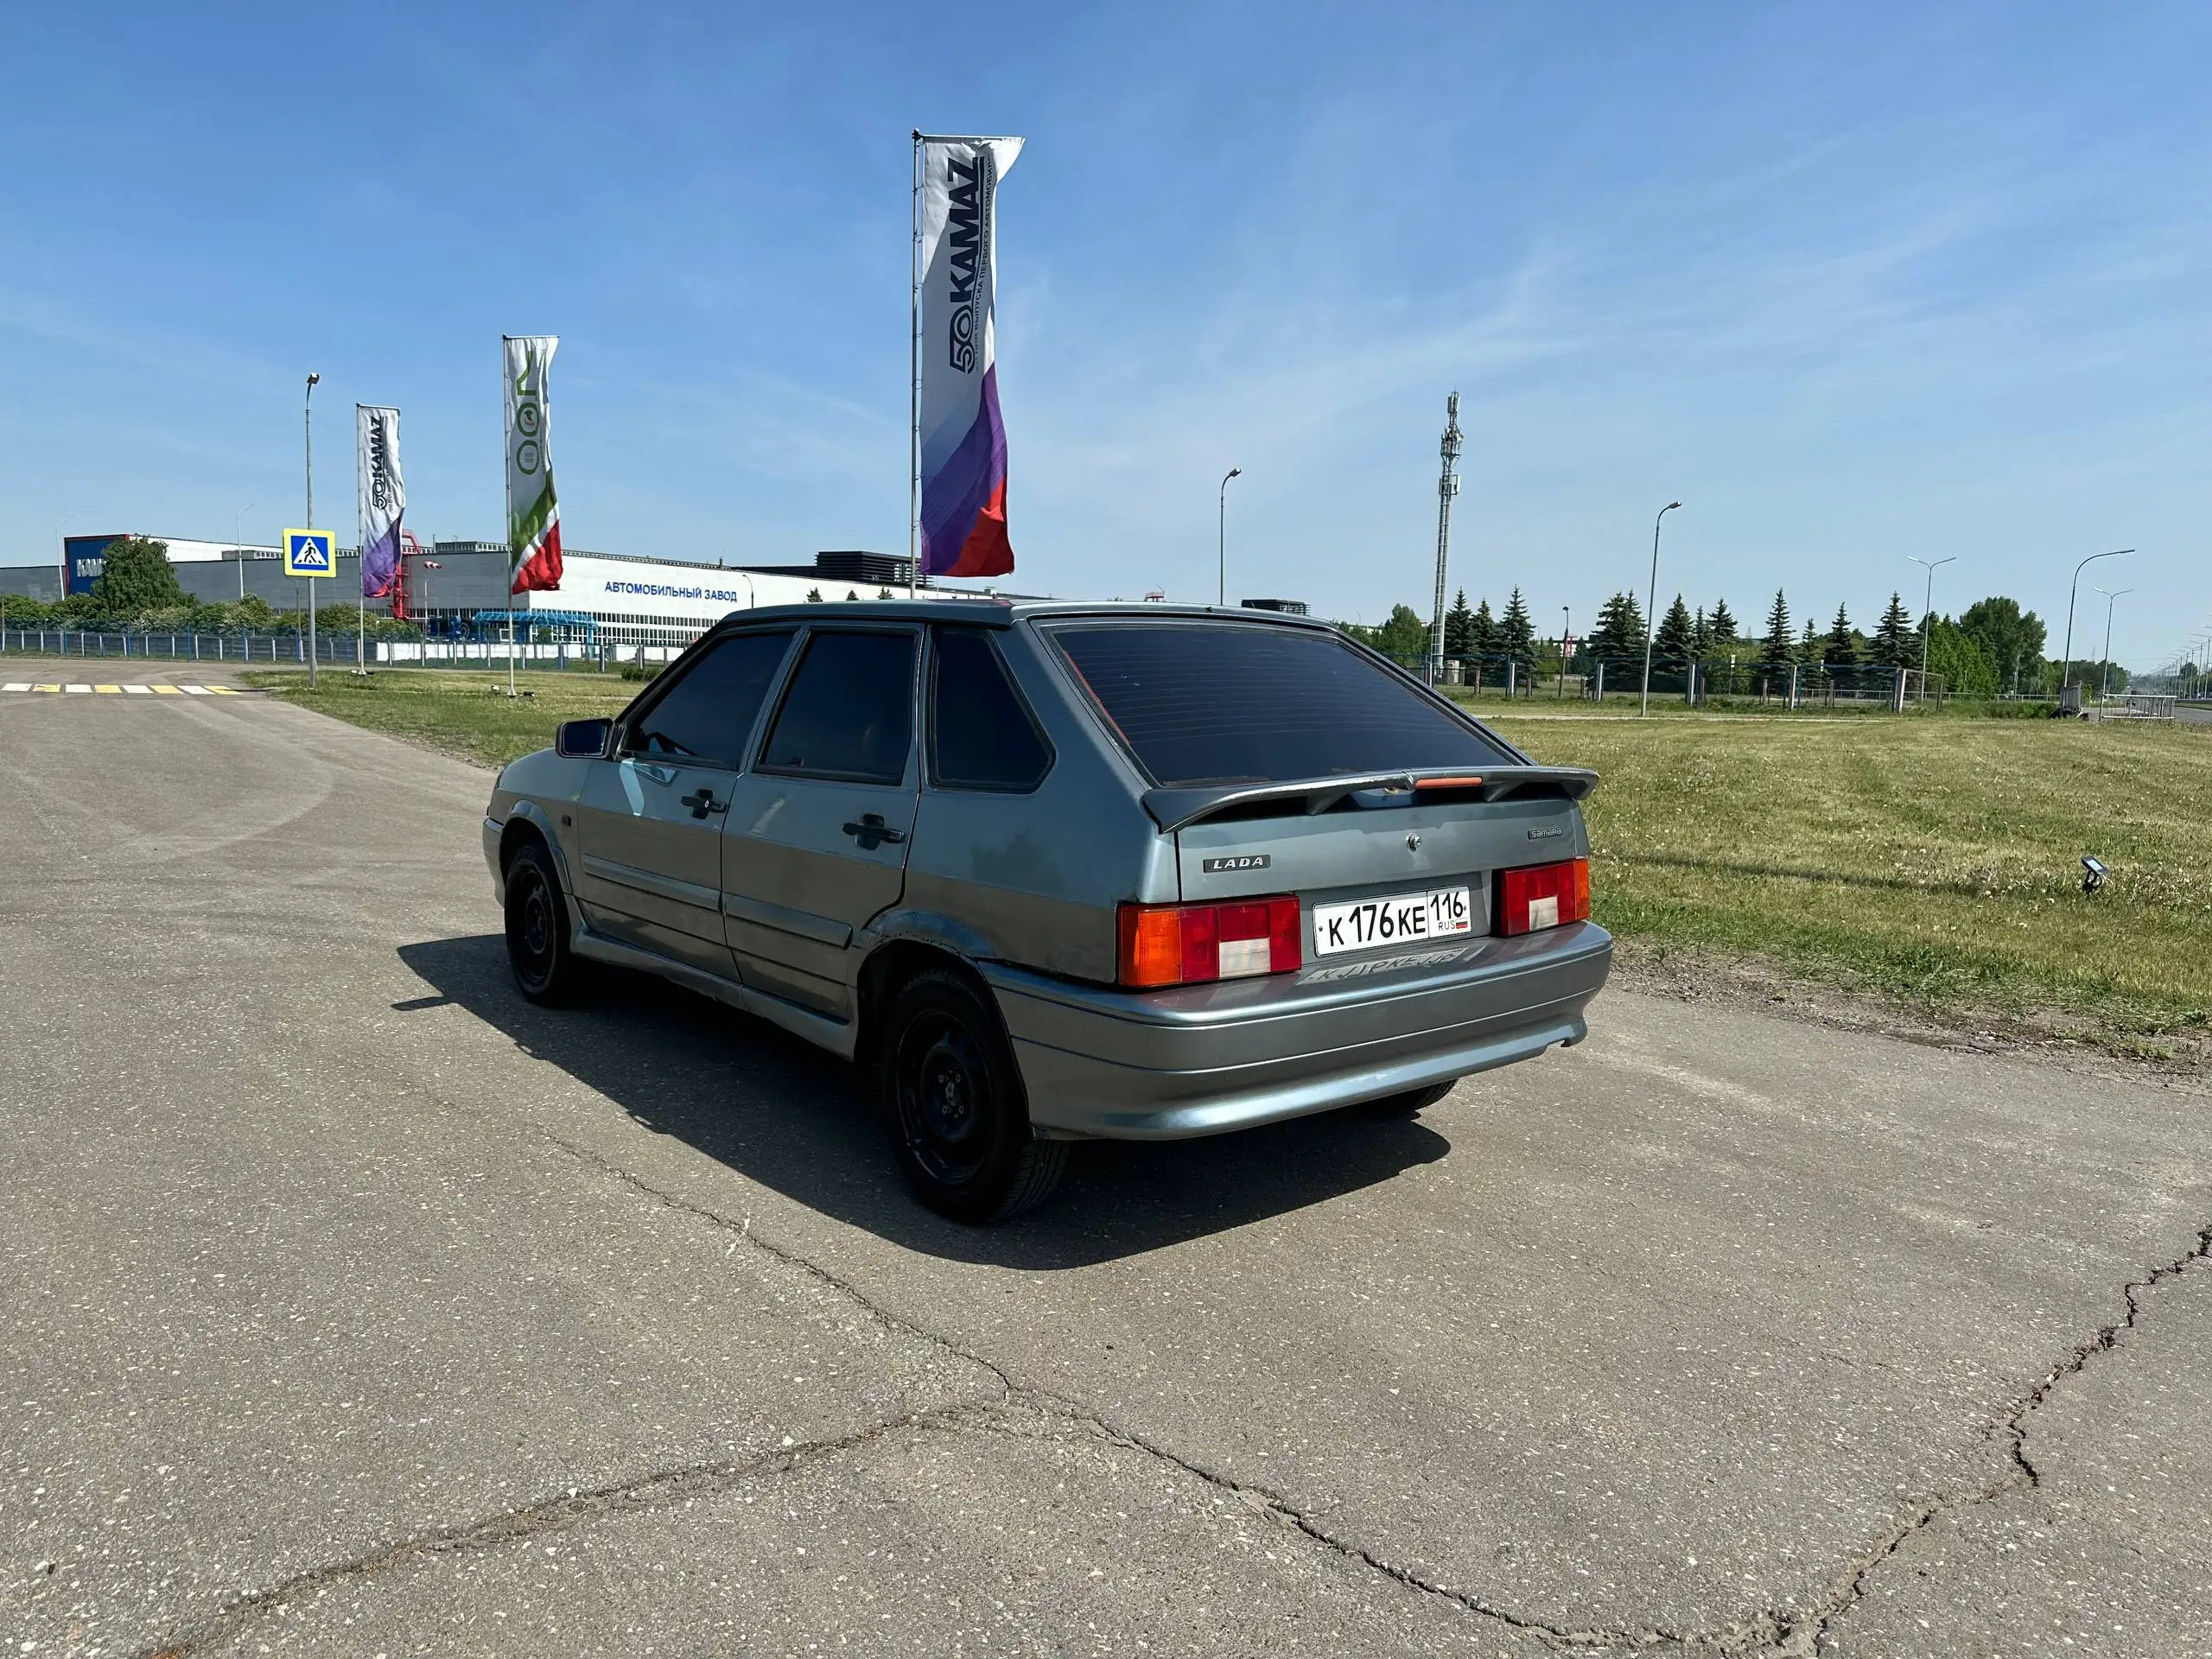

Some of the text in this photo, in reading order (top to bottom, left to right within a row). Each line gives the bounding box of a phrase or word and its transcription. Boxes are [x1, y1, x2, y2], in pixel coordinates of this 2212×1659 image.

[980, 231, 989, 277] ПЕРВОГО
[604, 581, 737, 603] АВТОМОБИЛЬНЫЙ ЗАВОД
[1212, 856, 1264, 869] LADA
[1430, 891, 1464, 921] 116
[1438, 920, 1456, 931] RUS
